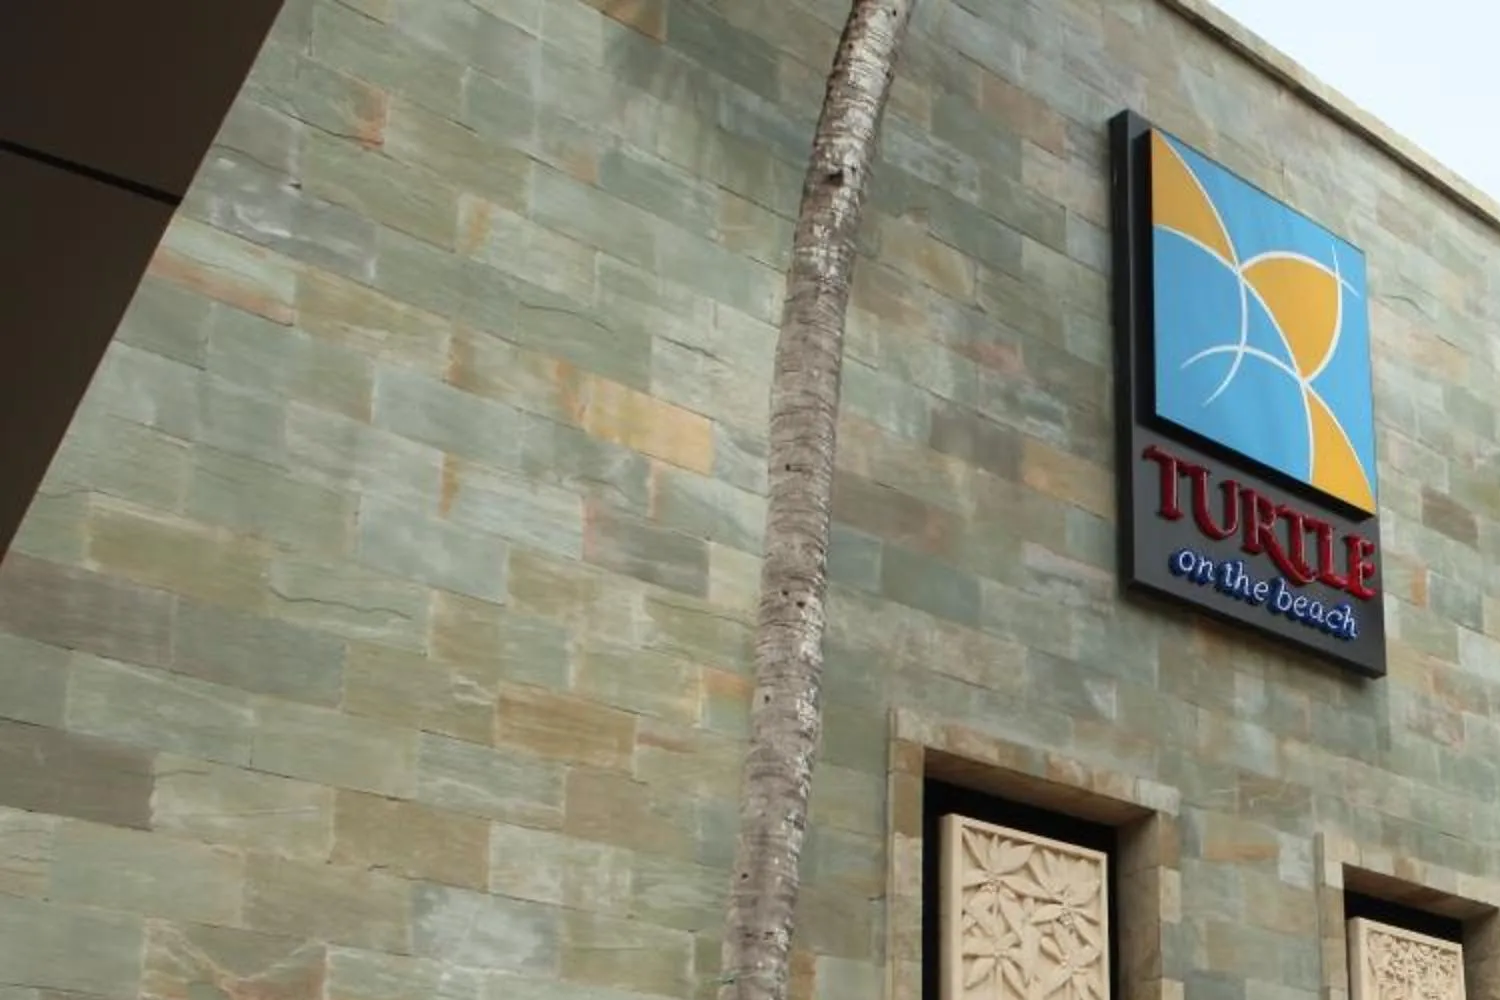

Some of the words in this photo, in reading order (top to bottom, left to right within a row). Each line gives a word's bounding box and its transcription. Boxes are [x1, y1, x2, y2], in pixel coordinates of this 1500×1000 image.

[1143, 444, 1376, 601] TURTLE
[1174, 549, 1214, 583] on
[1222, 560, 1269, 602] the
[1273, 577, 1359, 639] beach
